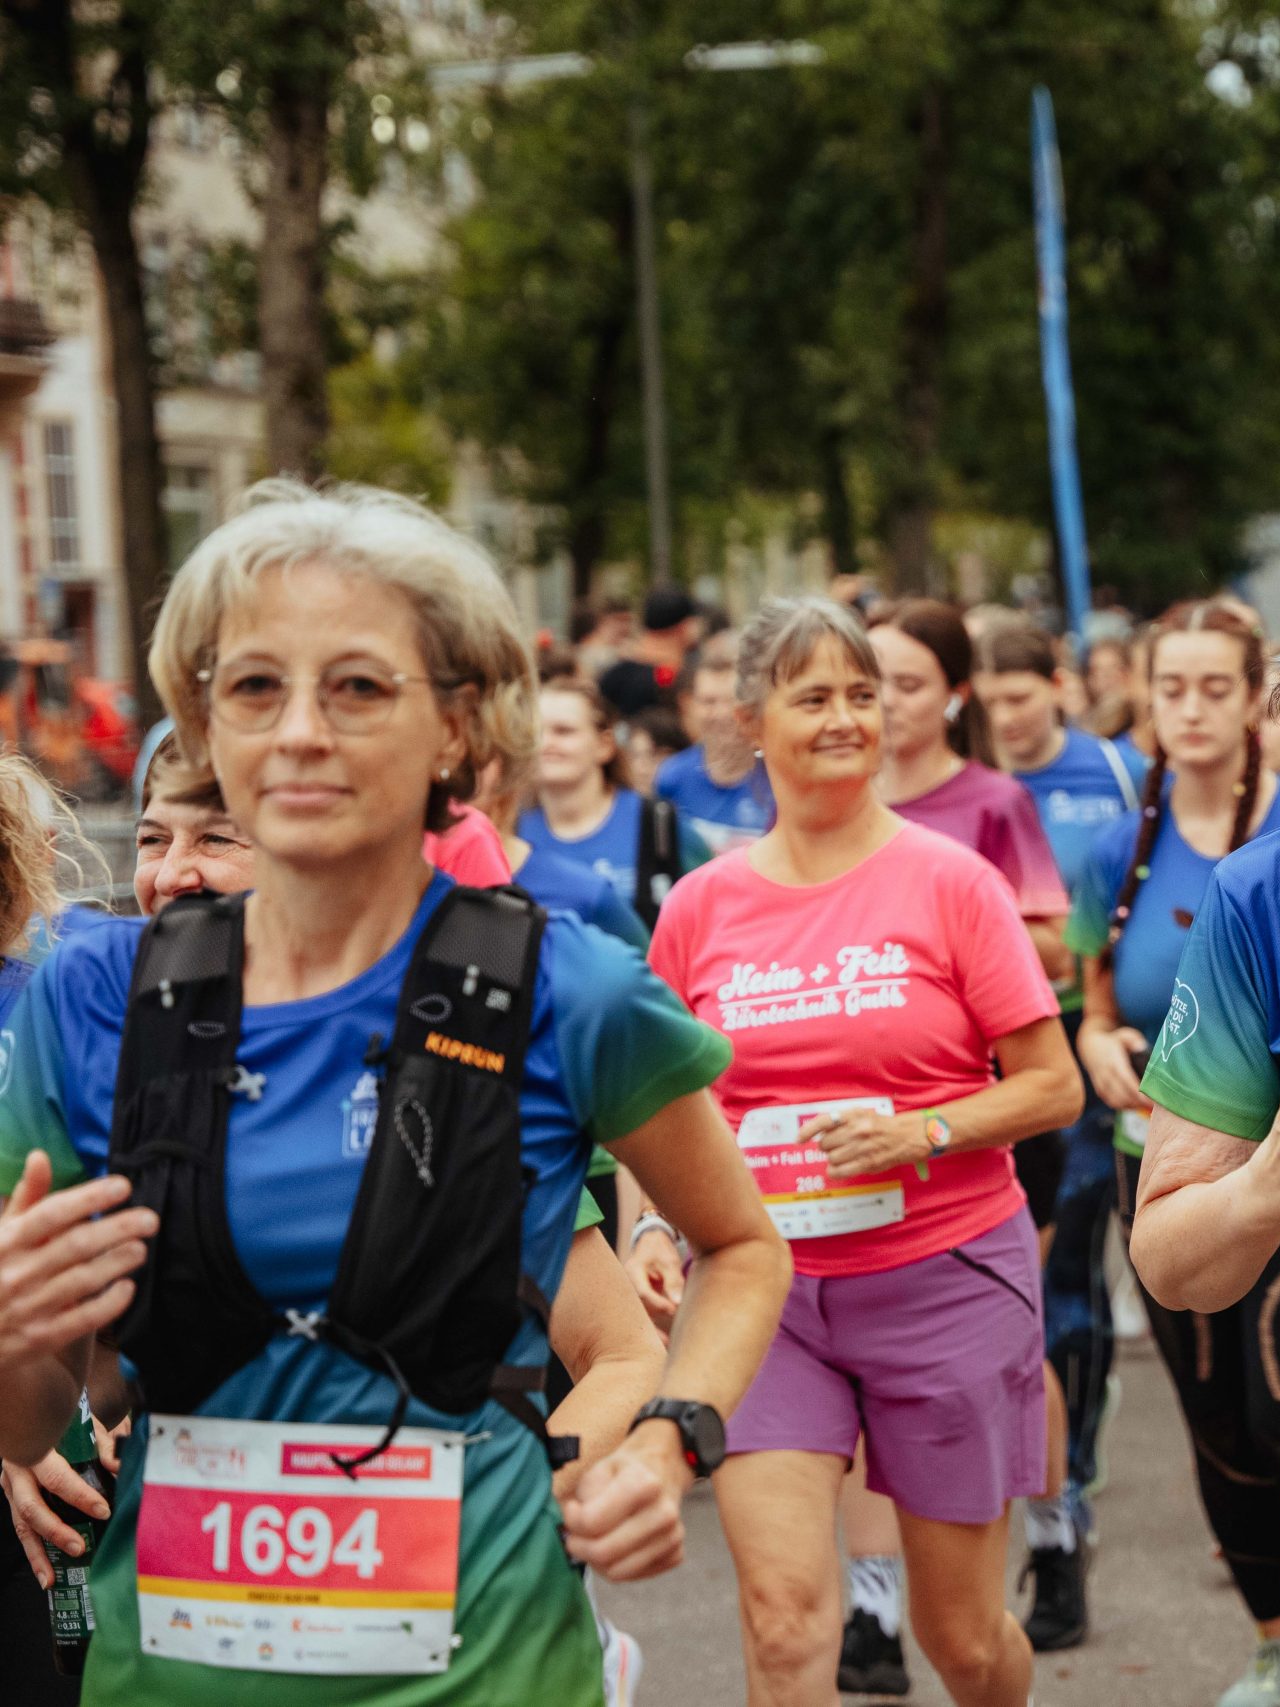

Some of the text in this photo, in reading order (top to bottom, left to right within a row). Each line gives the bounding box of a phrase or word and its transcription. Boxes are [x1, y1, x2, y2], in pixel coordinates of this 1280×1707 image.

[810, 963, 830, 984] +
[1171, 994, 1188, 1016] ÜTZE,
[202, 1501, 383, 1579] 1694
